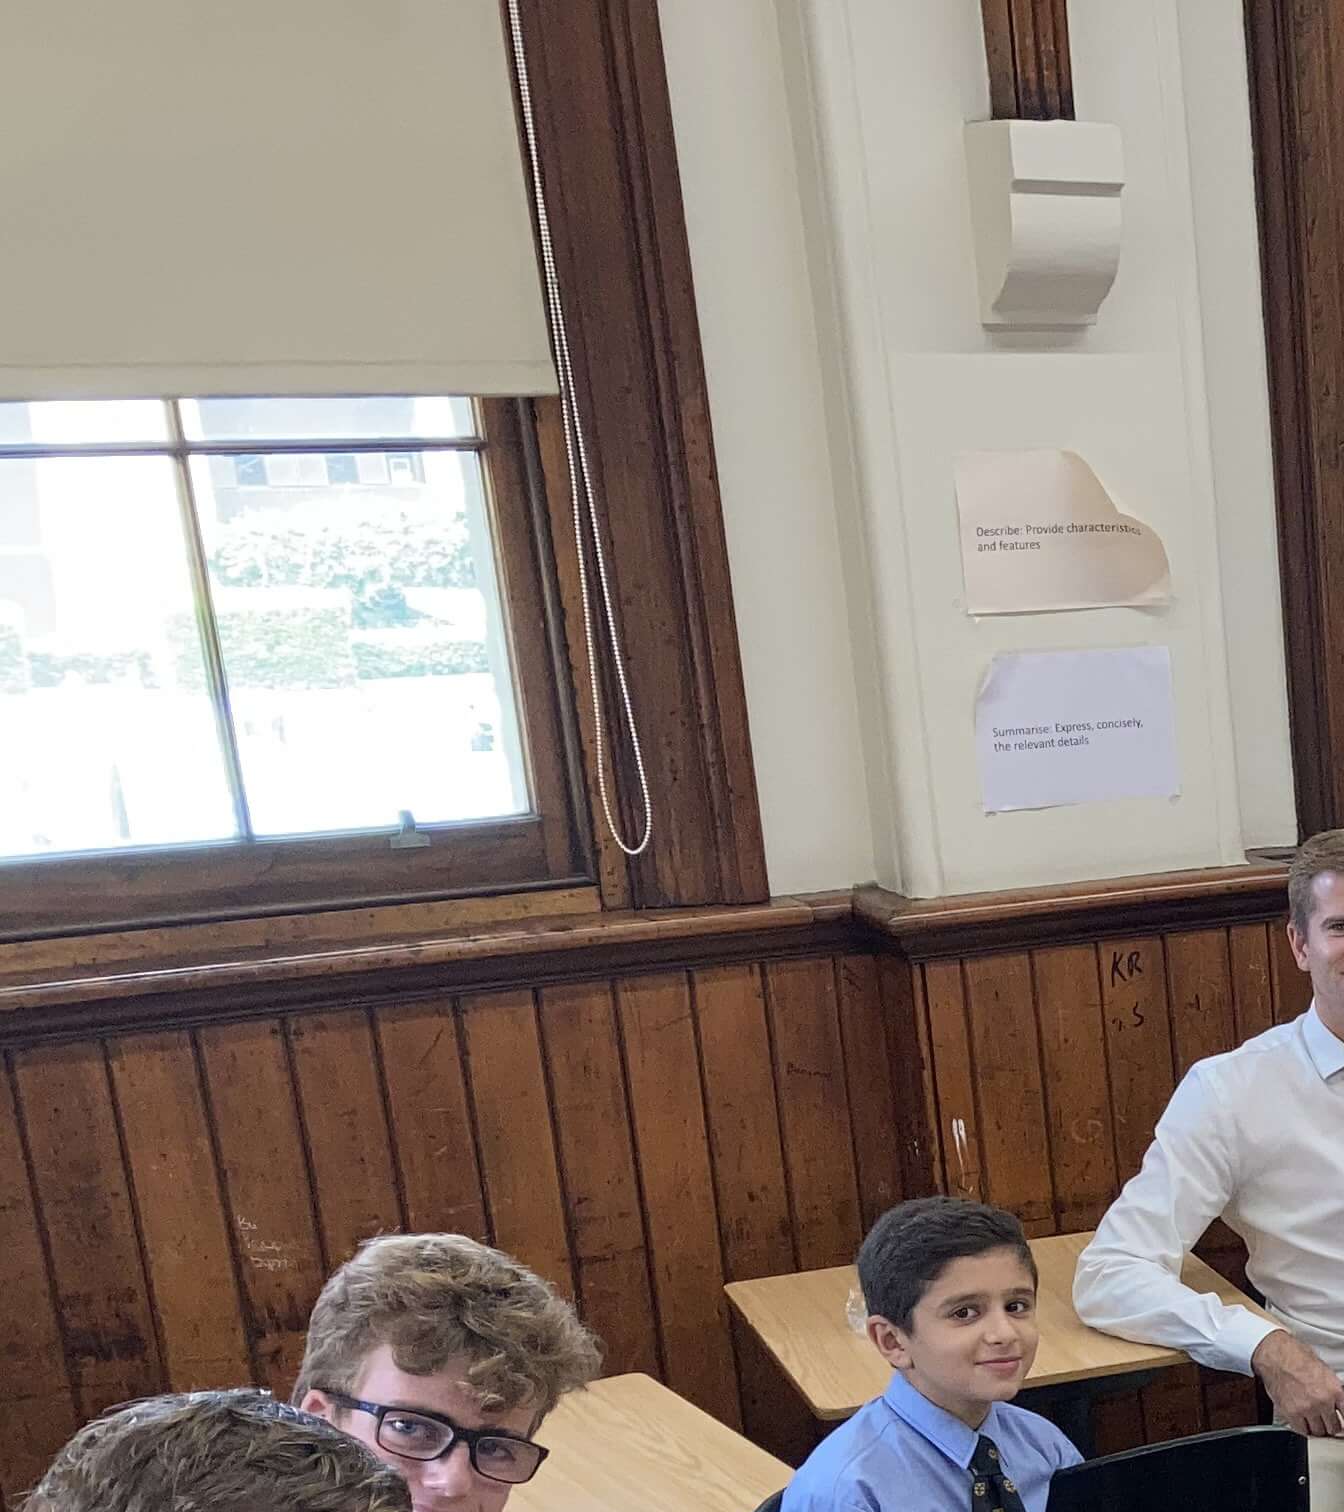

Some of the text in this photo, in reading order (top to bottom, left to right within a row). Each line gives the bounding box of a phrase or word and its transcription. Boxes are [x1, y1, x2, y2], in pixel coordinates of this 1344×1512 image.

[976, 525, 1023, 537] Describe:
[1026, 524, 1064, 535] Provide
[977, 540, 1041, 552] and features
[1055, 722, 1094, 734] Express,
[1096, 718, 1144, 730] concisely,
[994, 735, 1090, 752] the relevant details
